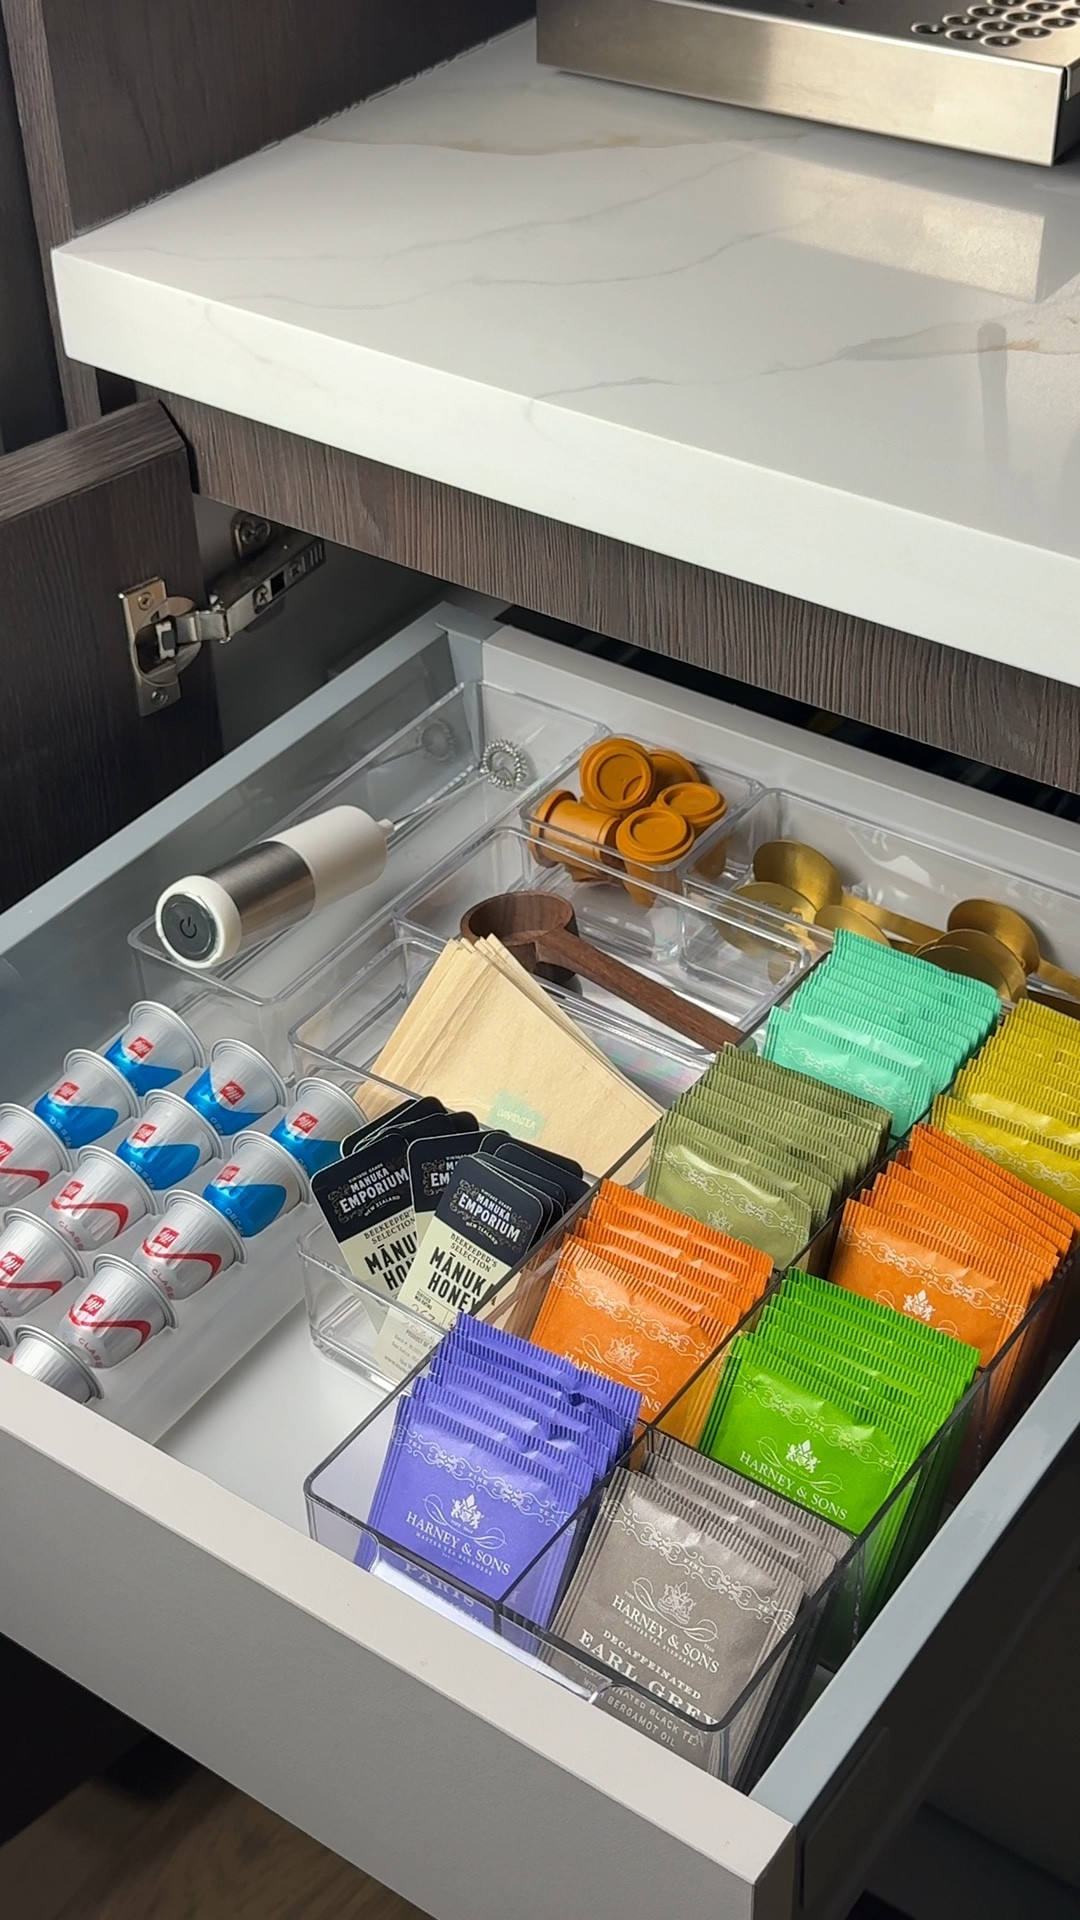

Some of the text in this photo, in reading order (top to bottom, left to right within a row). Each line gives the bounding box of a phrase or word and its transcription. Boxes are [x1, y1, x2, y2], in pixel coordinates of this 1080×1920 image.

[339, 1167, 410, 1213] EMPORIUM
[350, 1167, 389, 1193] MANUKA
[458, 1192, 521, 1243] EMPORIUM
[476, 1193, 511, 1221] MANUKA
[450, 1233, 498, 1268] BEEKEEPER'S
[450, 1243, 492, 1273] SELECTION
[642, 1394, 662, 1413] NS
[739, 1451, 795, 1491] HARNEY
[796, 1486, 807, 1500] &
[812, 1493, 848, 1520] SONS
[406, 1511, 460, 1549] HARNEY
[461, 1542, 472, 1557] &
[475, 1549, 511, 1575] SONS
[579, 1629, 638, 1682] EARL
[612, 1594, 719, 1673] HARNEY & SONS
[602, 1629, 701, 1700] DECAFFEINATED
[607, 1695, 659, 1734] BERGAMOT
[660, 1731, 676, 1748] OIL
[649, 1707, 679, 1734] BLACK
